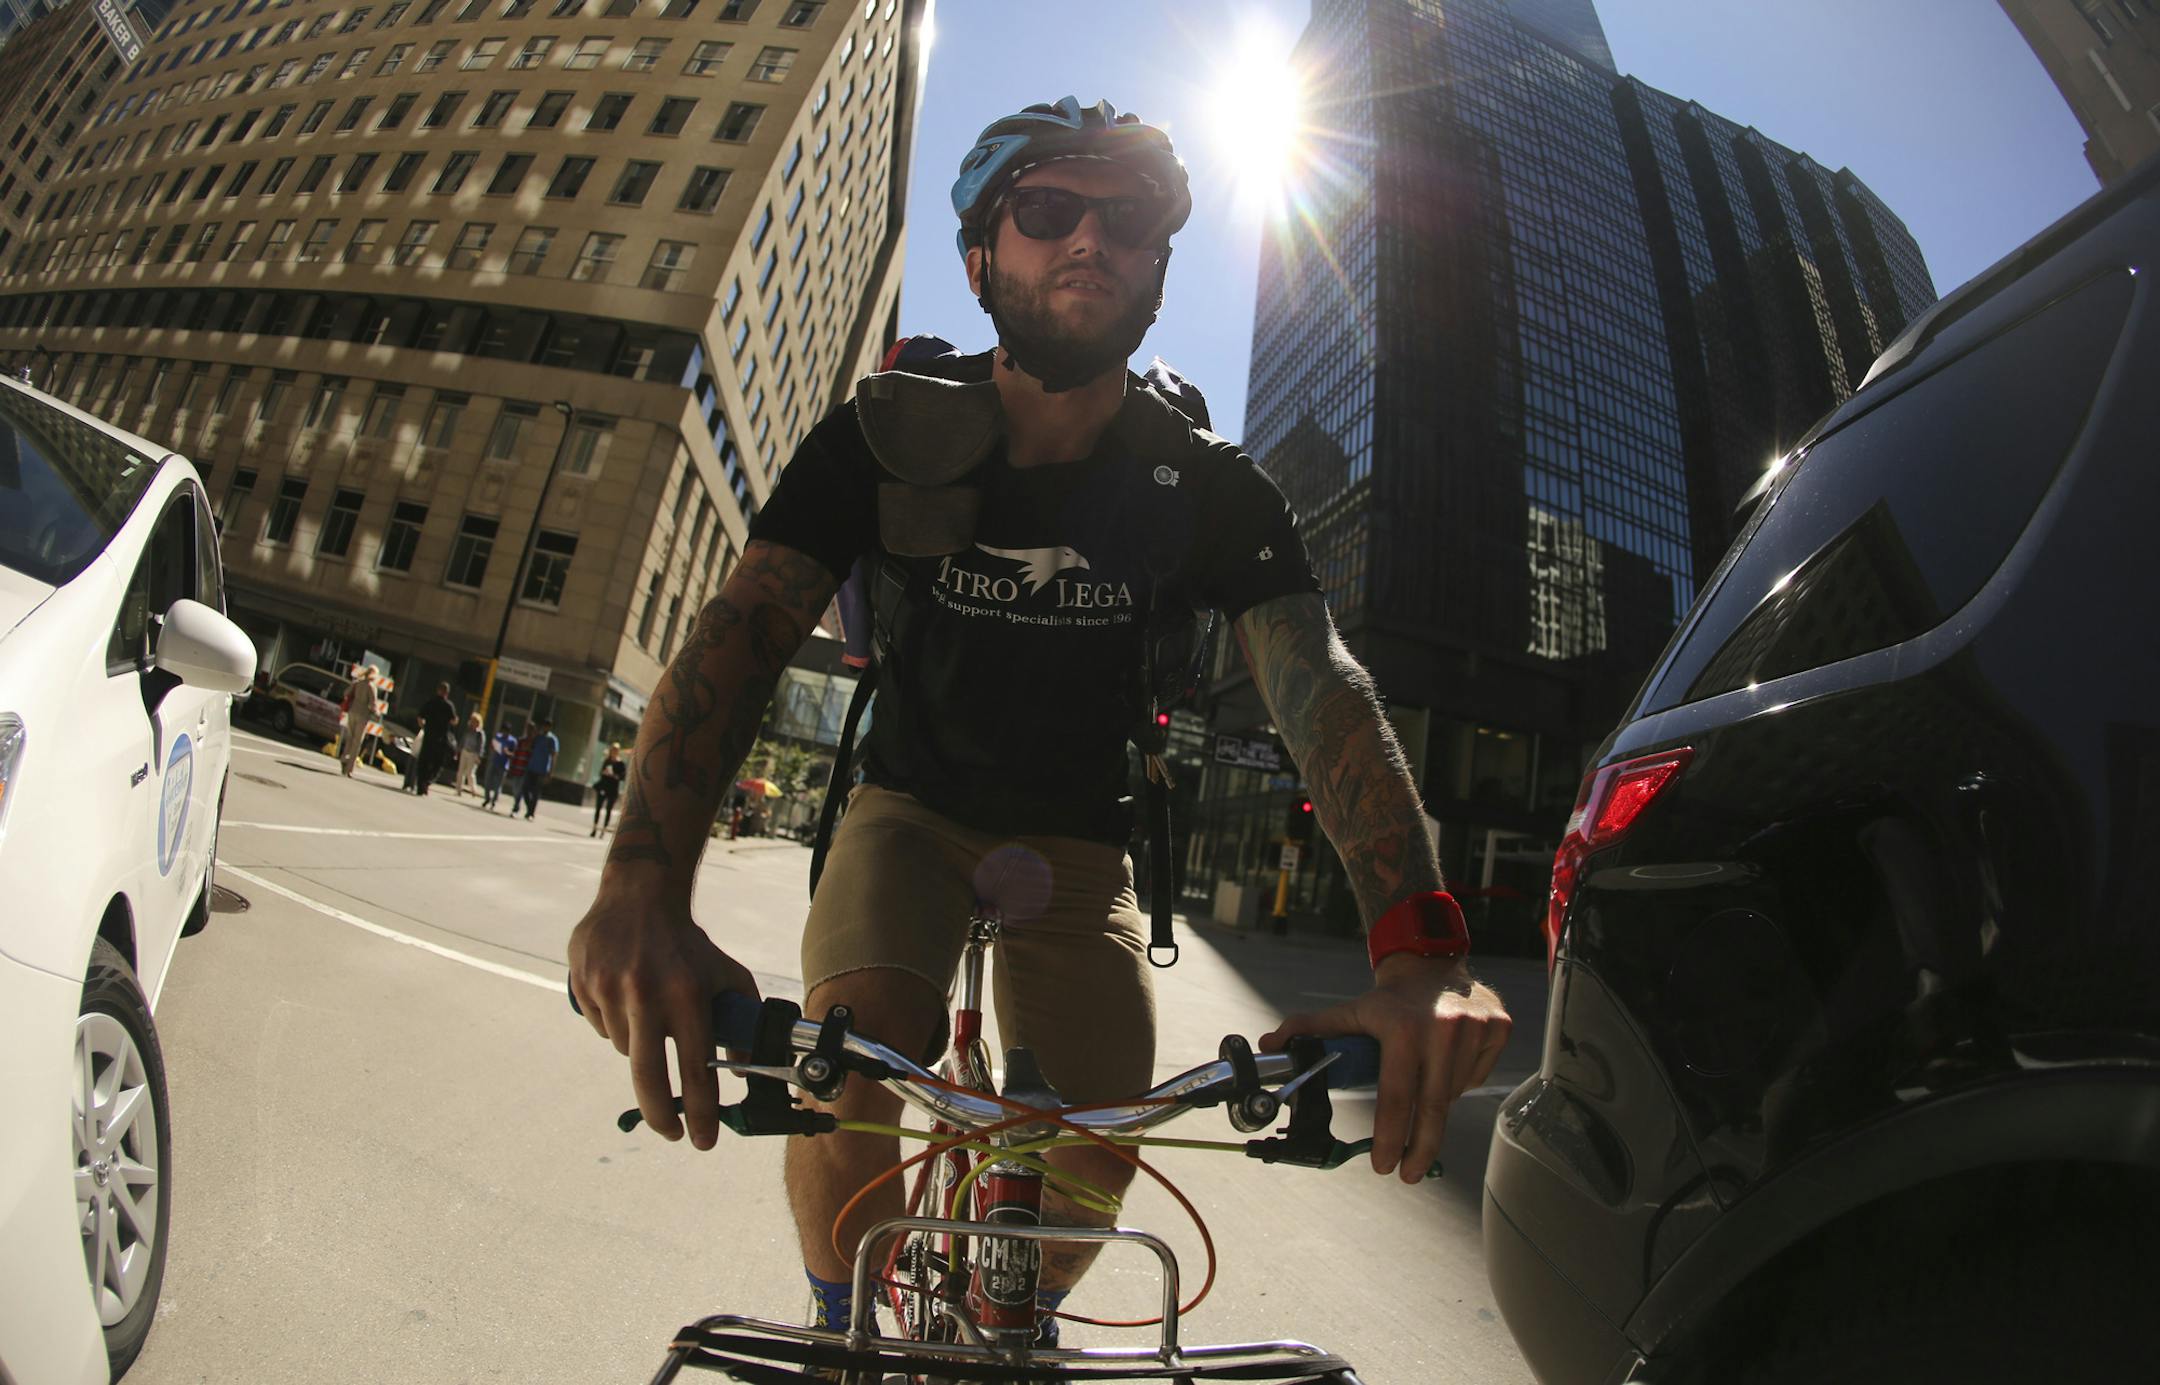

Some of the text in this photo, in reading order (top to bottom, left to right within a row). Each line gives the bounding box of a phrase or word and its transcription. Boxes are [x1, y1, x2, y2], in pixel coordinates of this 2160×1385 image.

[99, 0, 131, 47] BAKER
[1056, 579, 1133, 608] LEGA
[947, 601, 1002, 617] support
[1006, 612, 1072, 626] specialists
[1076, 616, 1109, 626] since
